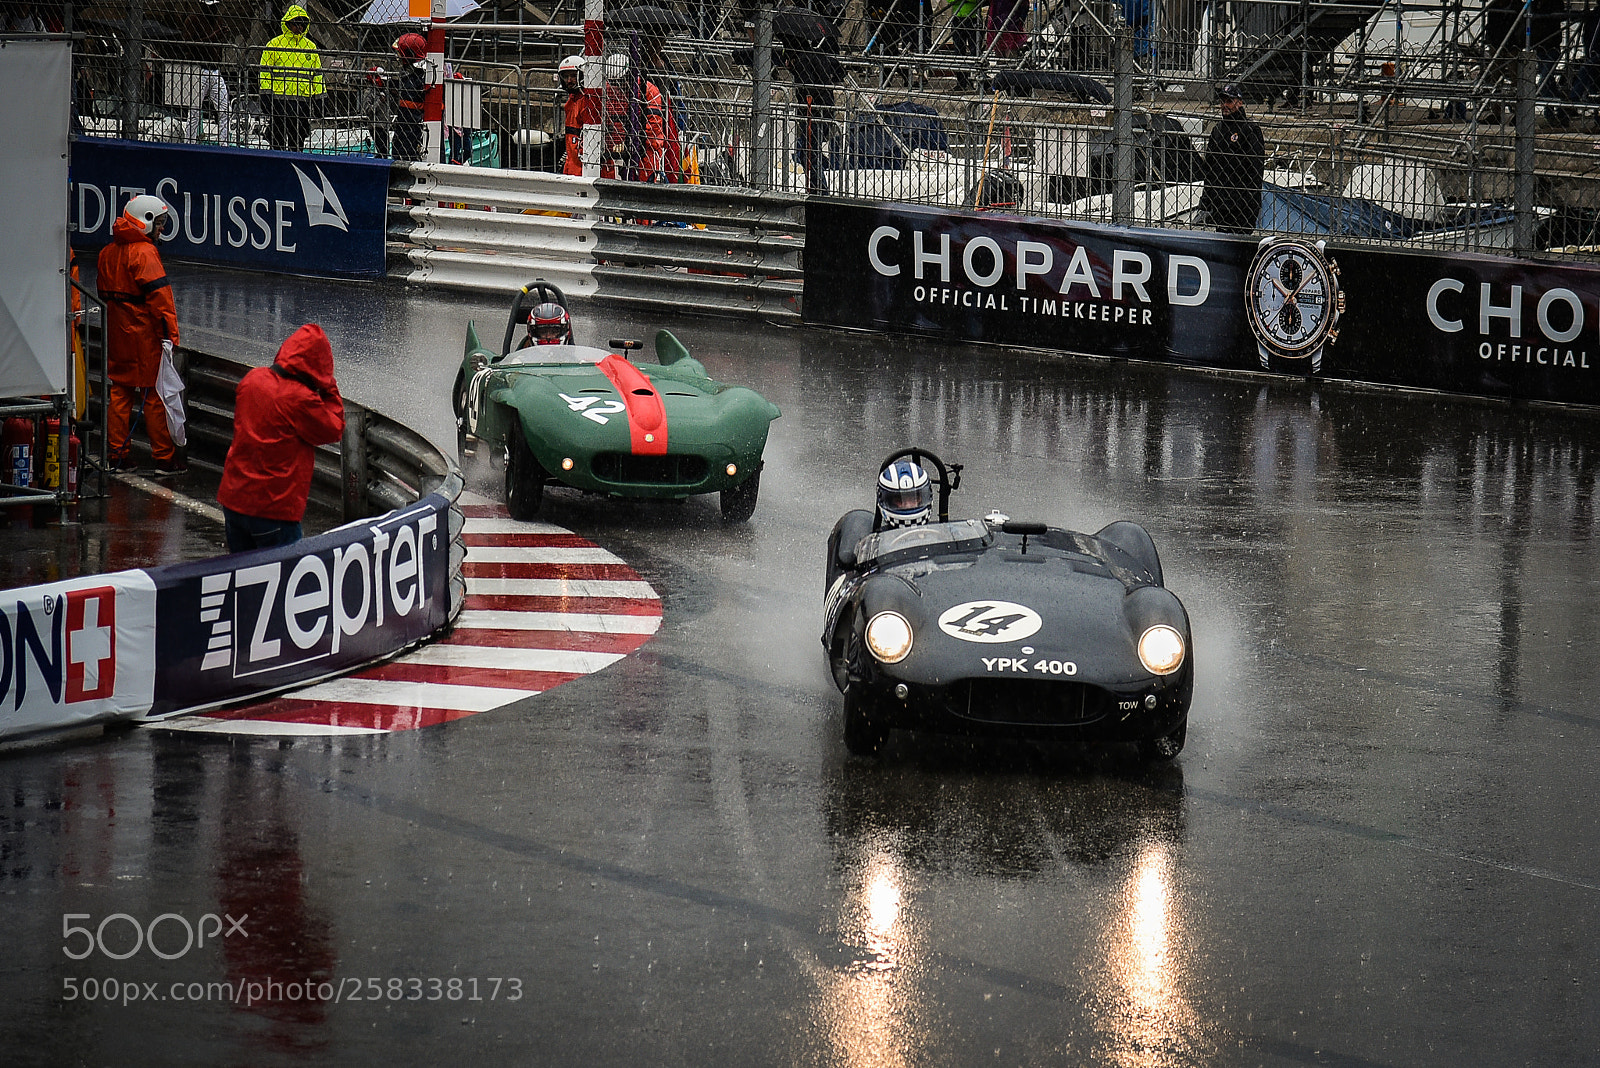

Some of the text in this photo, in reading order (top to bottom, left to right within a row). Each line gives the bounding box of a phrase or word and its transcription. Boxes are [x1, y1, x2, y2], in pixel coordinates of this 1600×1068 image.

[155, 177, 297, 252] SUISSE
[868, 225, 1211, 307] CHOPARD
[914, 286, 1152, 325] OFFICIAL TIMEKEEPER
[1426, 277, 1600, 346] CHO
[1478, 342, 1590, 369] OFFICIAL
[558, 393, 626, 425] 42
[945, 605, 1028, 636] 14
[981, 657, 1078, 676] YPK 400
[1118, 700, 1139, 710] TOW
